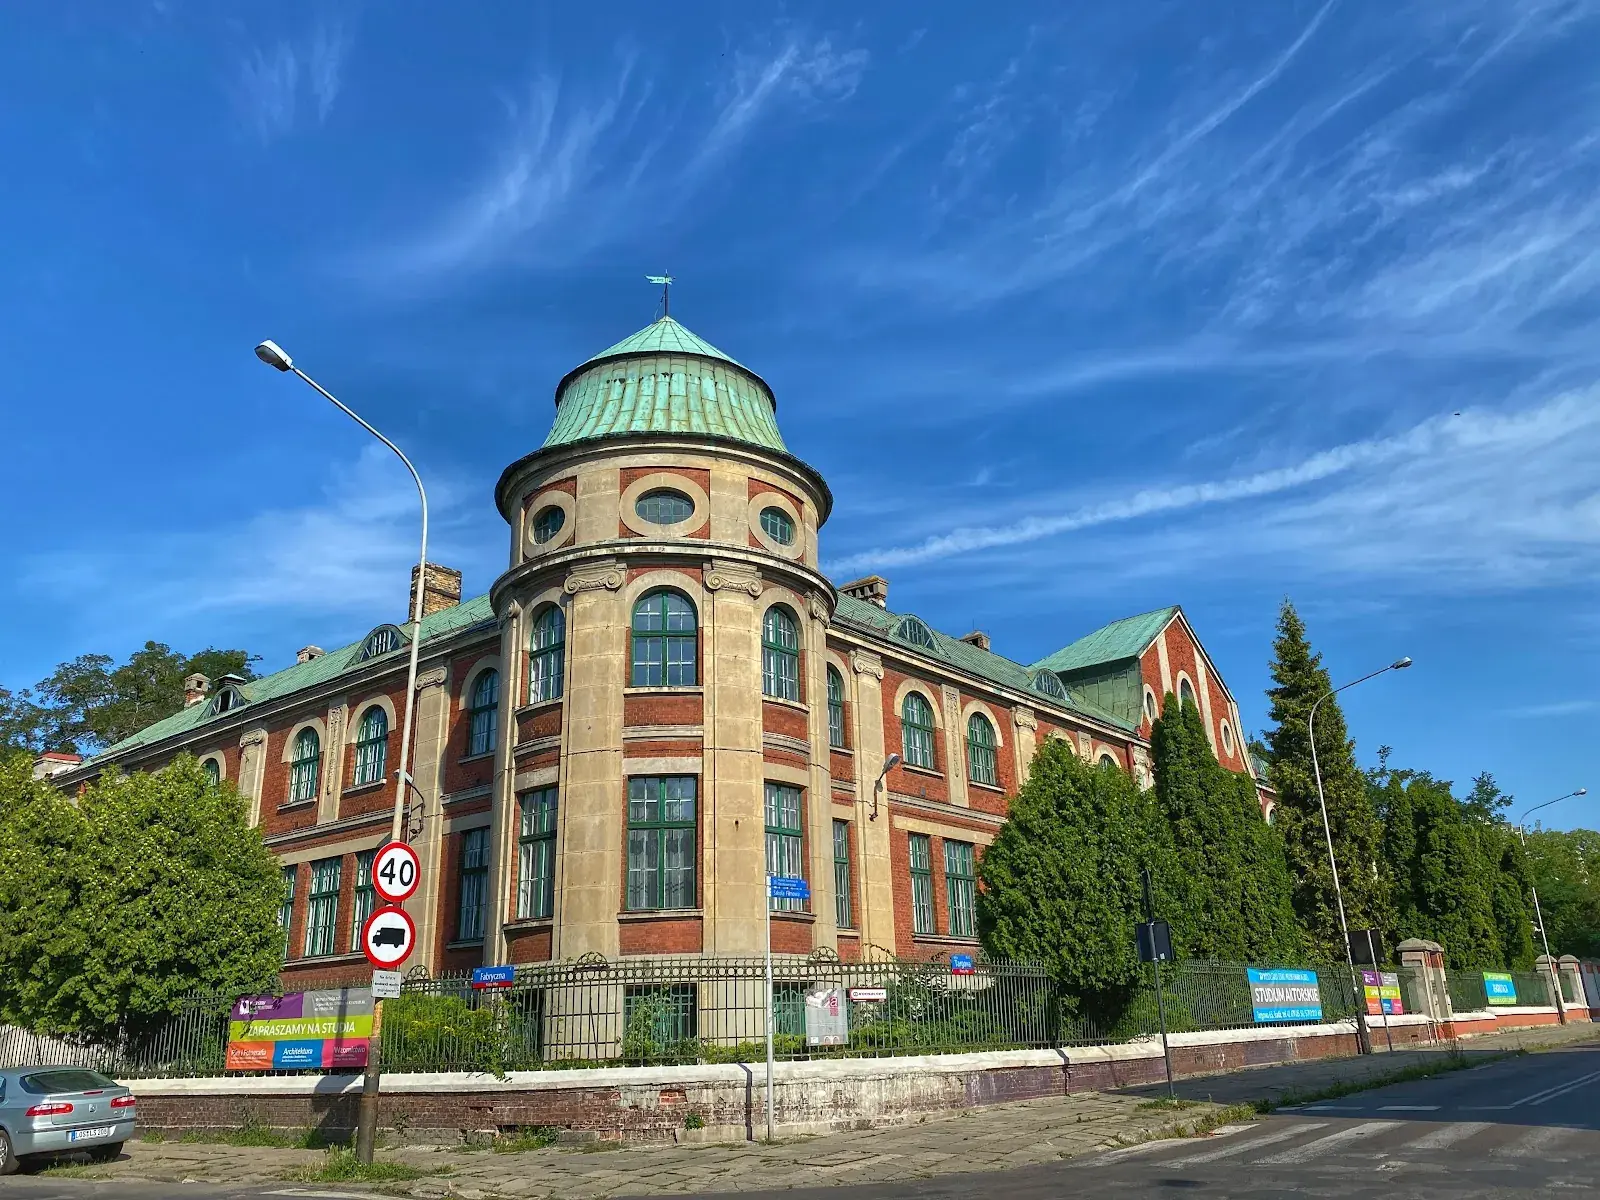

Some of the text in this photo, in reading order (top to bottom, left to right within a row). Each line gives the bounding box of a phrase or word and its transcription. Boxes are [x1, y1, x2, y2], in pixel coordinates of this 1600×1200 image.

[379, 857, 414, 887] 40
[480, 972, 506, 982] Fabryczna
[1254, 987, 1286, 1003] STUDIUM
[248, 1021, 356, 1037] ZAPRASZAMY NA STUDIA
[282, 1047, 314, 1055] Architektura
[333, 1045, 366, 1054] Wzornictwo
